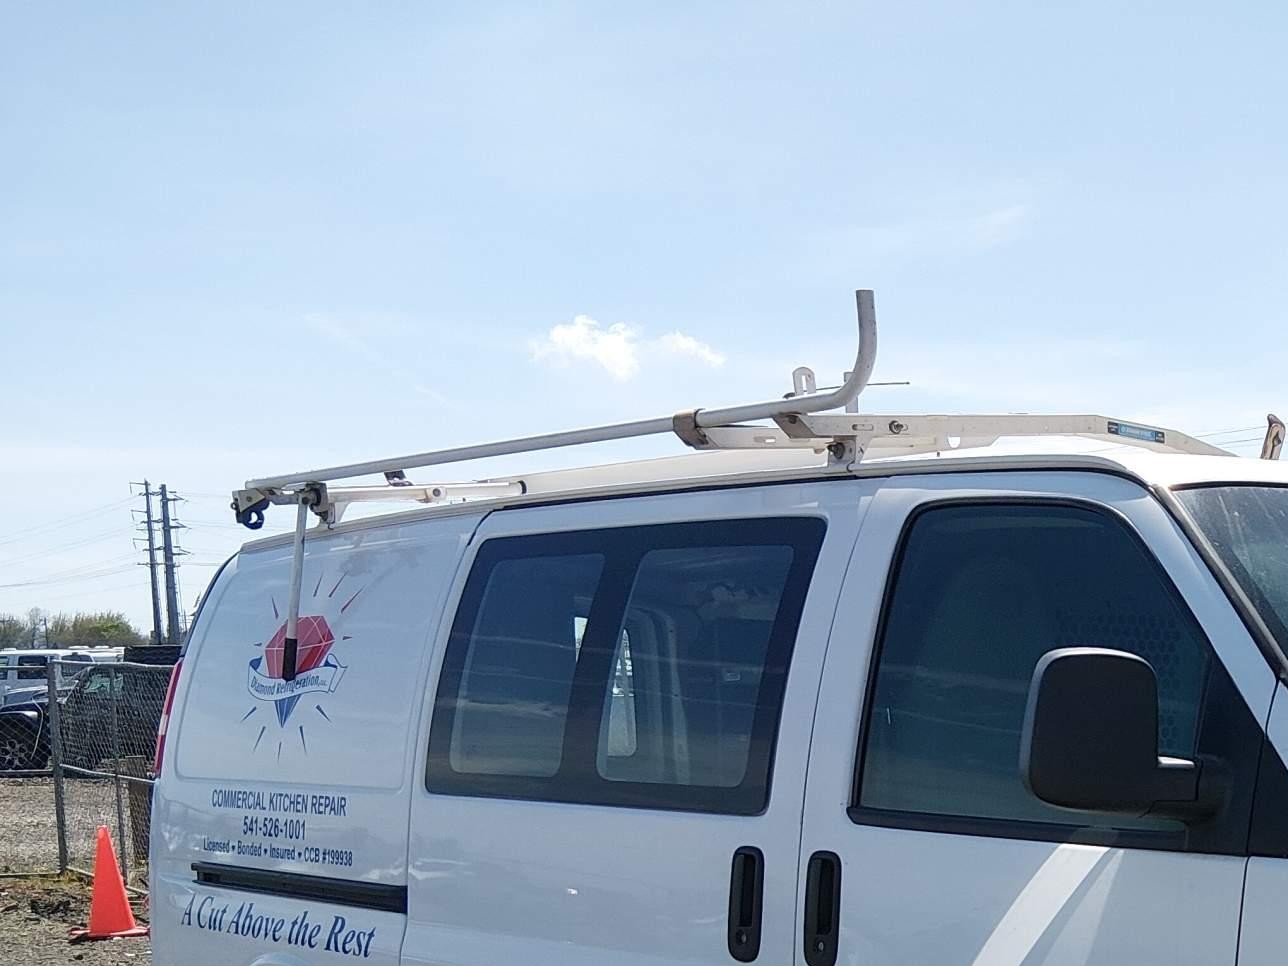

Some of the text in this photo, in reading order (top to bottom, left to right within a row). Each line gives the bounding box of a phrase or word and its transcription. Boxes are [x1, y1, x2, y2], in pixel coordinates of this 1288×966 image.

[250, 676, 275, 696] Diamond
[212, 789, 347, 816] COMMERCIAL KITCHEN REPAIR
[243, 815, 306, 840] 541-526-1001
[203, 837, 353, 867] Licensed Bonded Insured CCB #199938
[181, 893, 377, 958] A Cut Above the Rest
